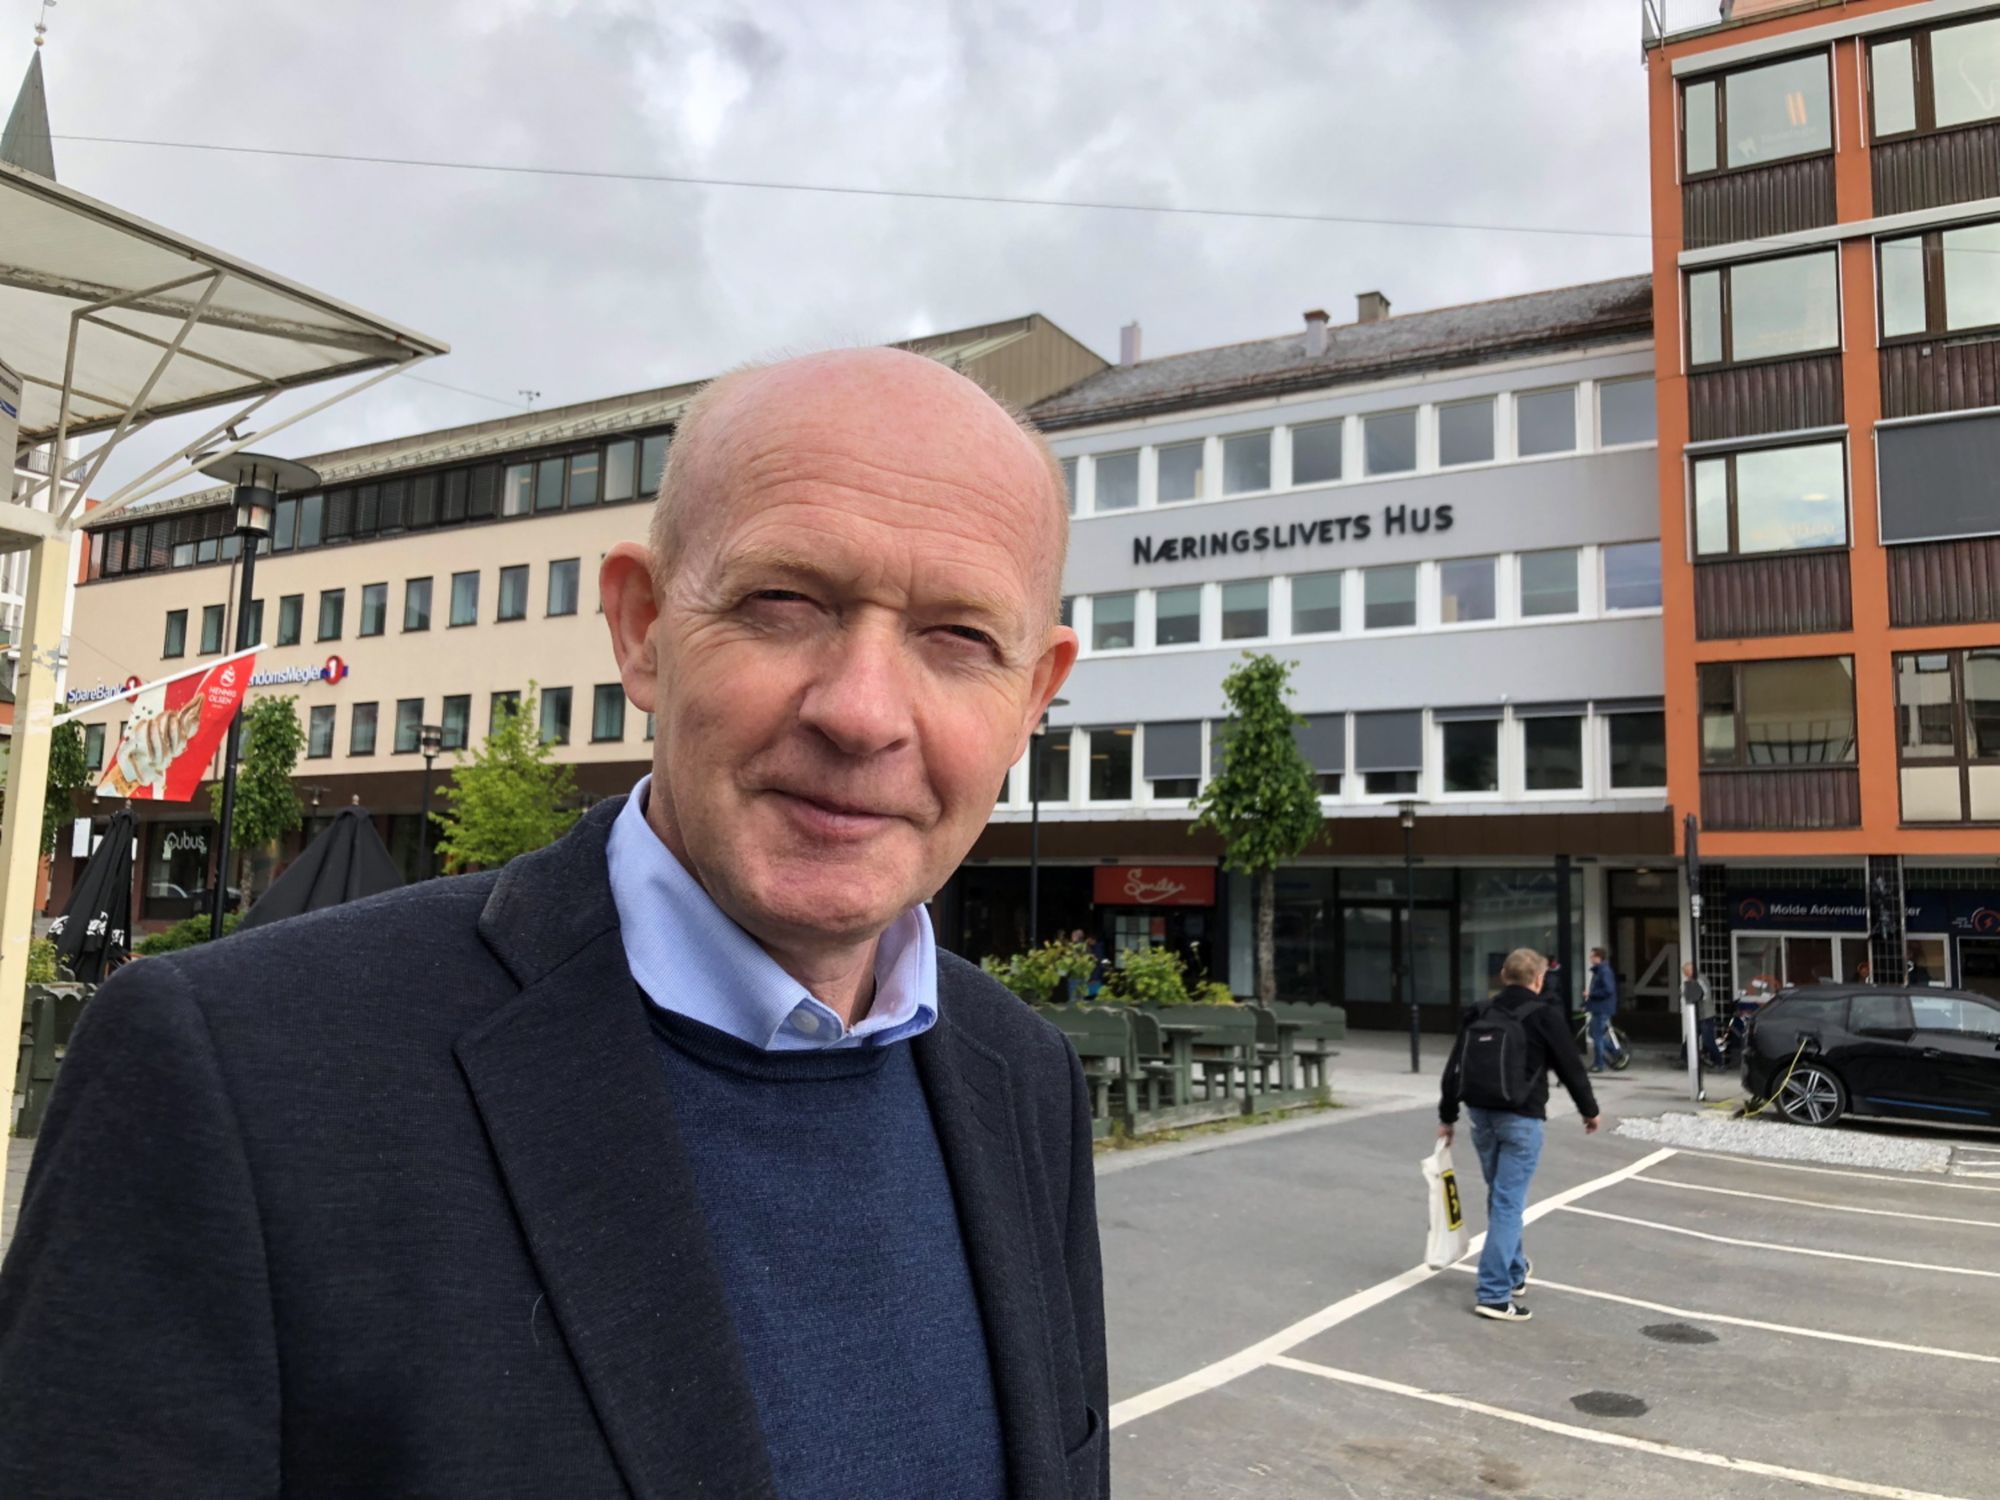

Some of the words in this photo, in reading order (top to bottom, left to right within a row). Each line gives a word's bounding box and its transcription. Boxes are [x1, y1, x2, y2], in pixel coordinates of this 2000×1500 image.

[1133, 514, 1371, 565] NÆRINGSLIVETS
[1384, 504, 1454, 536] HUS
[208, 686, 237, 698] HENNIG
[208, 695, 233, 705] OLSEN
[166, 830, 205, 850] Cubus
[1770, 903, 1808, 915] Molde
